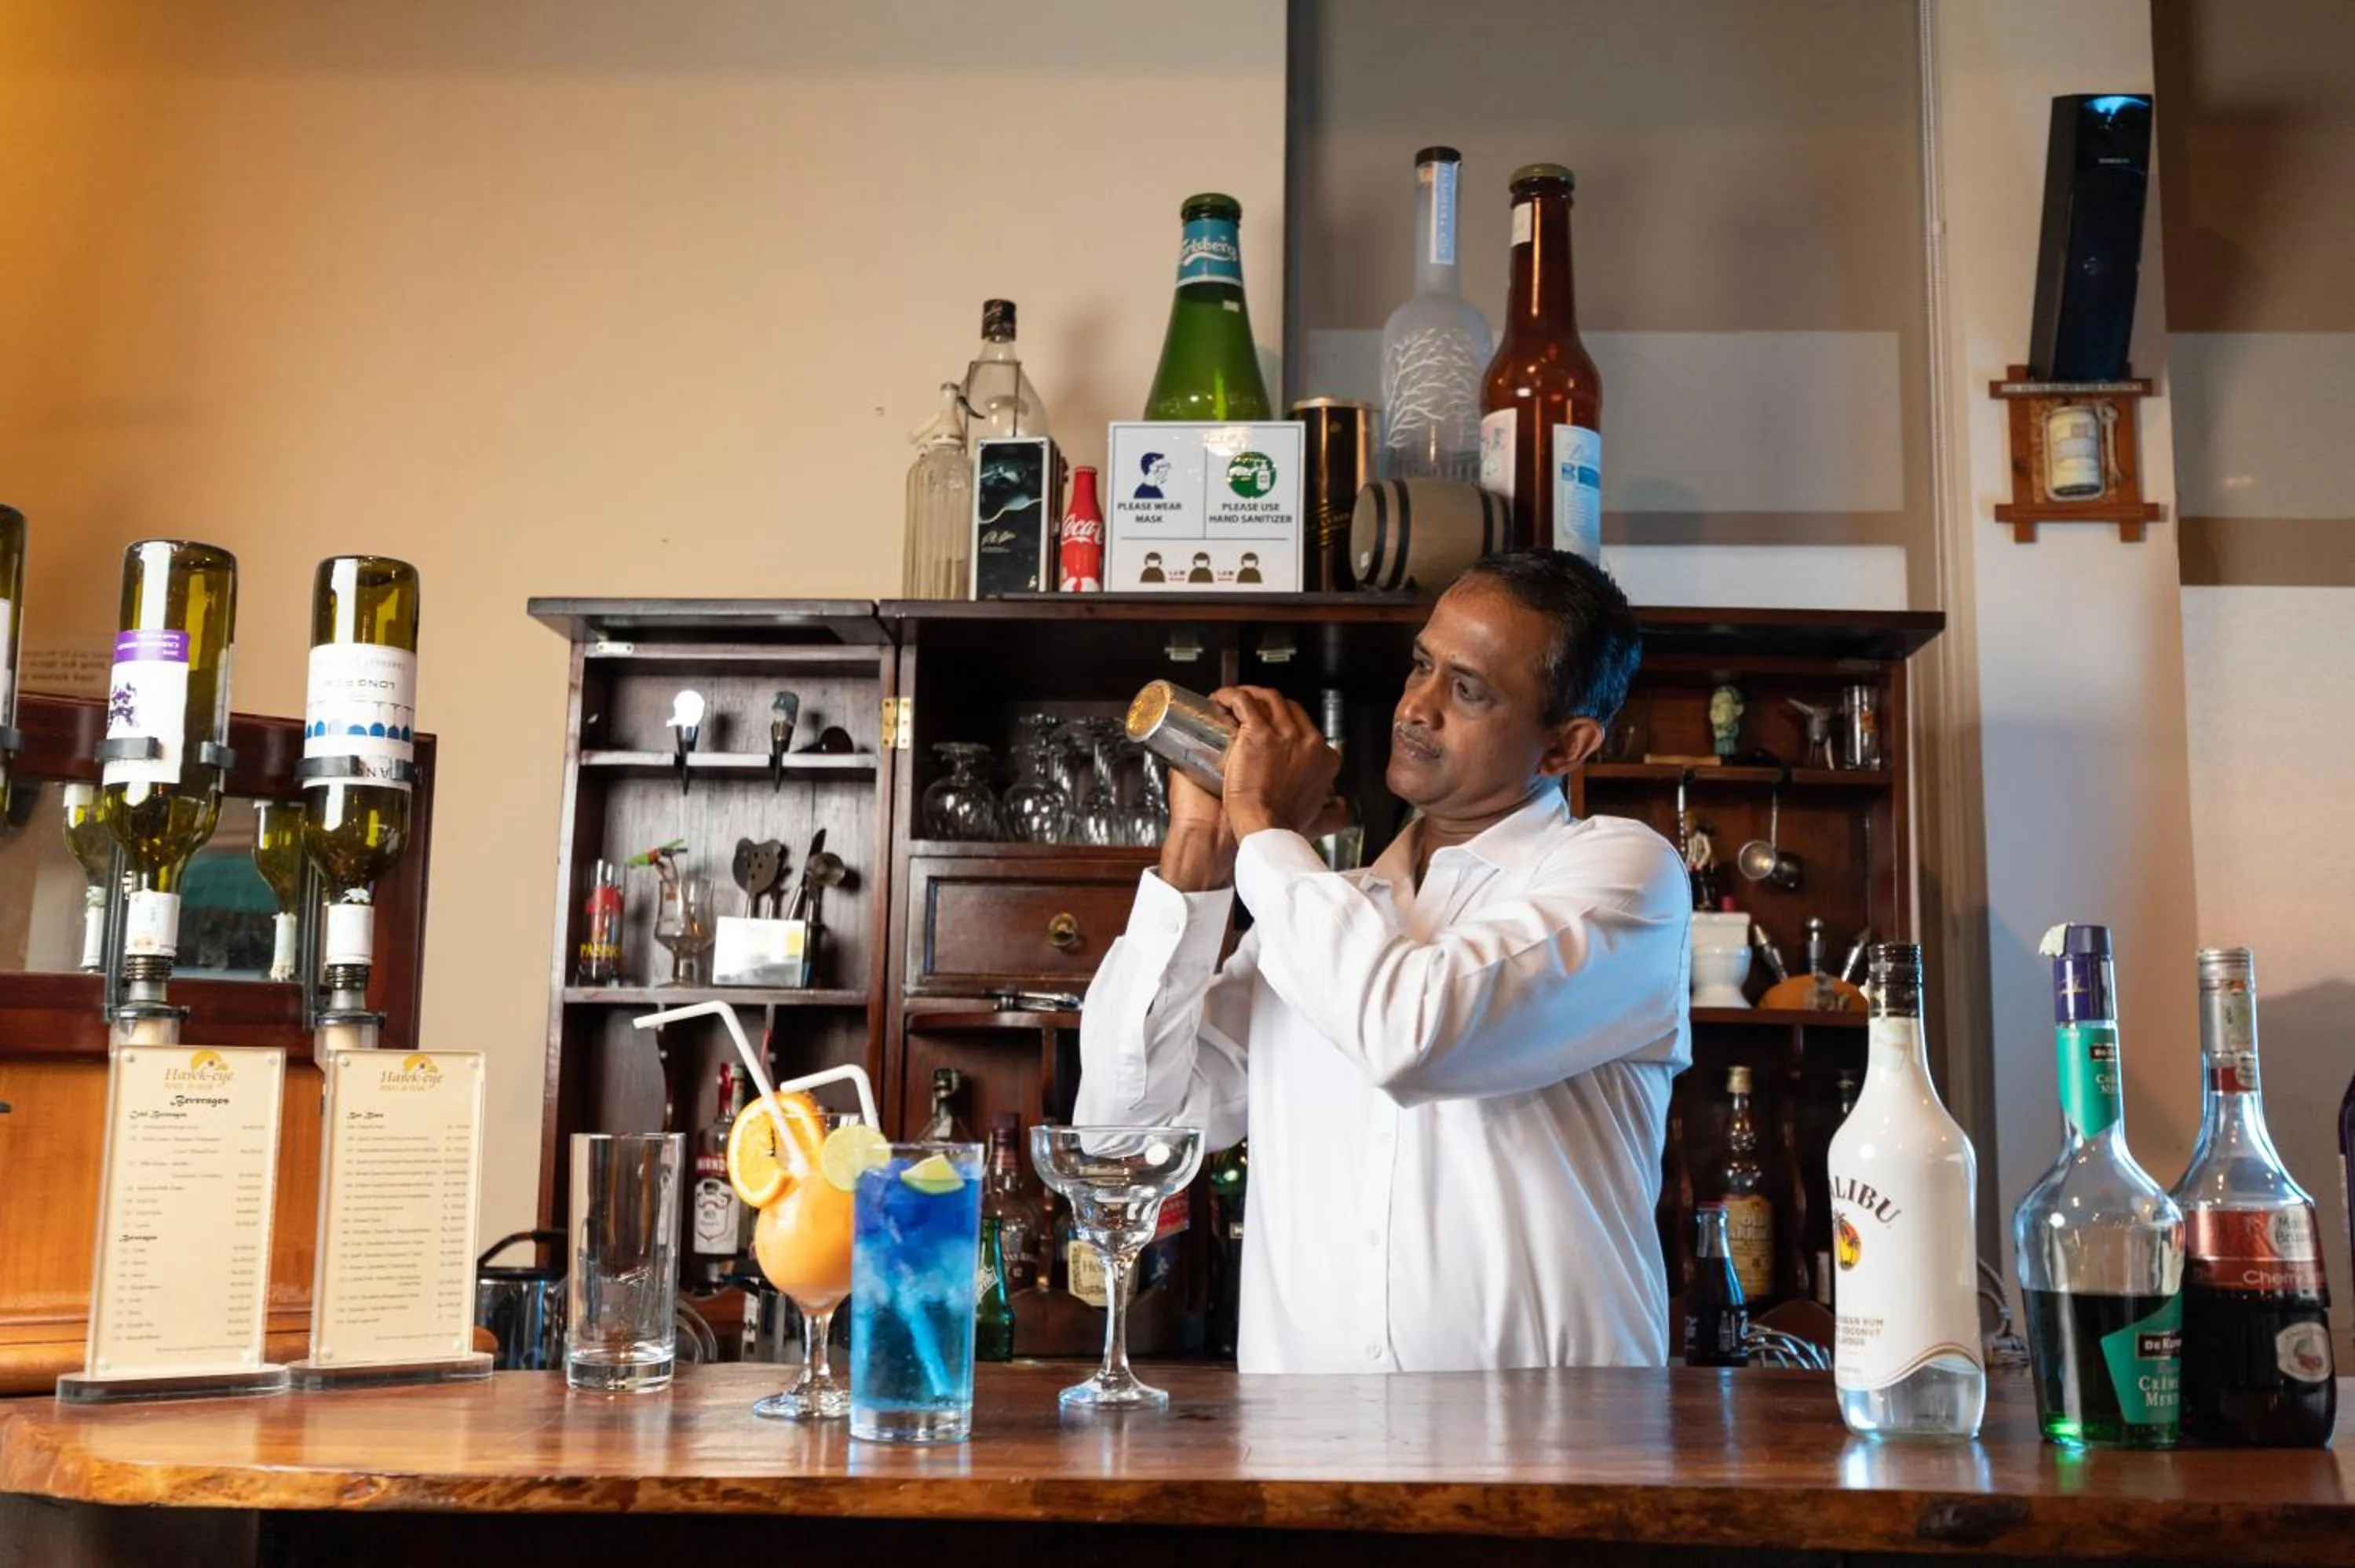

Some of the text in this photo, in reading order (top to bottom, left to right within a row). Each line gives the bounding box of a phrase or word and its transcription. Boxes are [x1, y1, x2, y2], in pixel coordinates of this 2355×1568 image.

[1117, 502, 1152, 511] PLEASE
[1222, 503, 1258, 512] PLEASE
[1135, 514, 1163, 523] MASK
[1209, 514, 1293, 523] HAND SANITIZER
[170, 1094, 229, 1107] Beverages
[1830, 1175, 1902, 1223] LIBU
